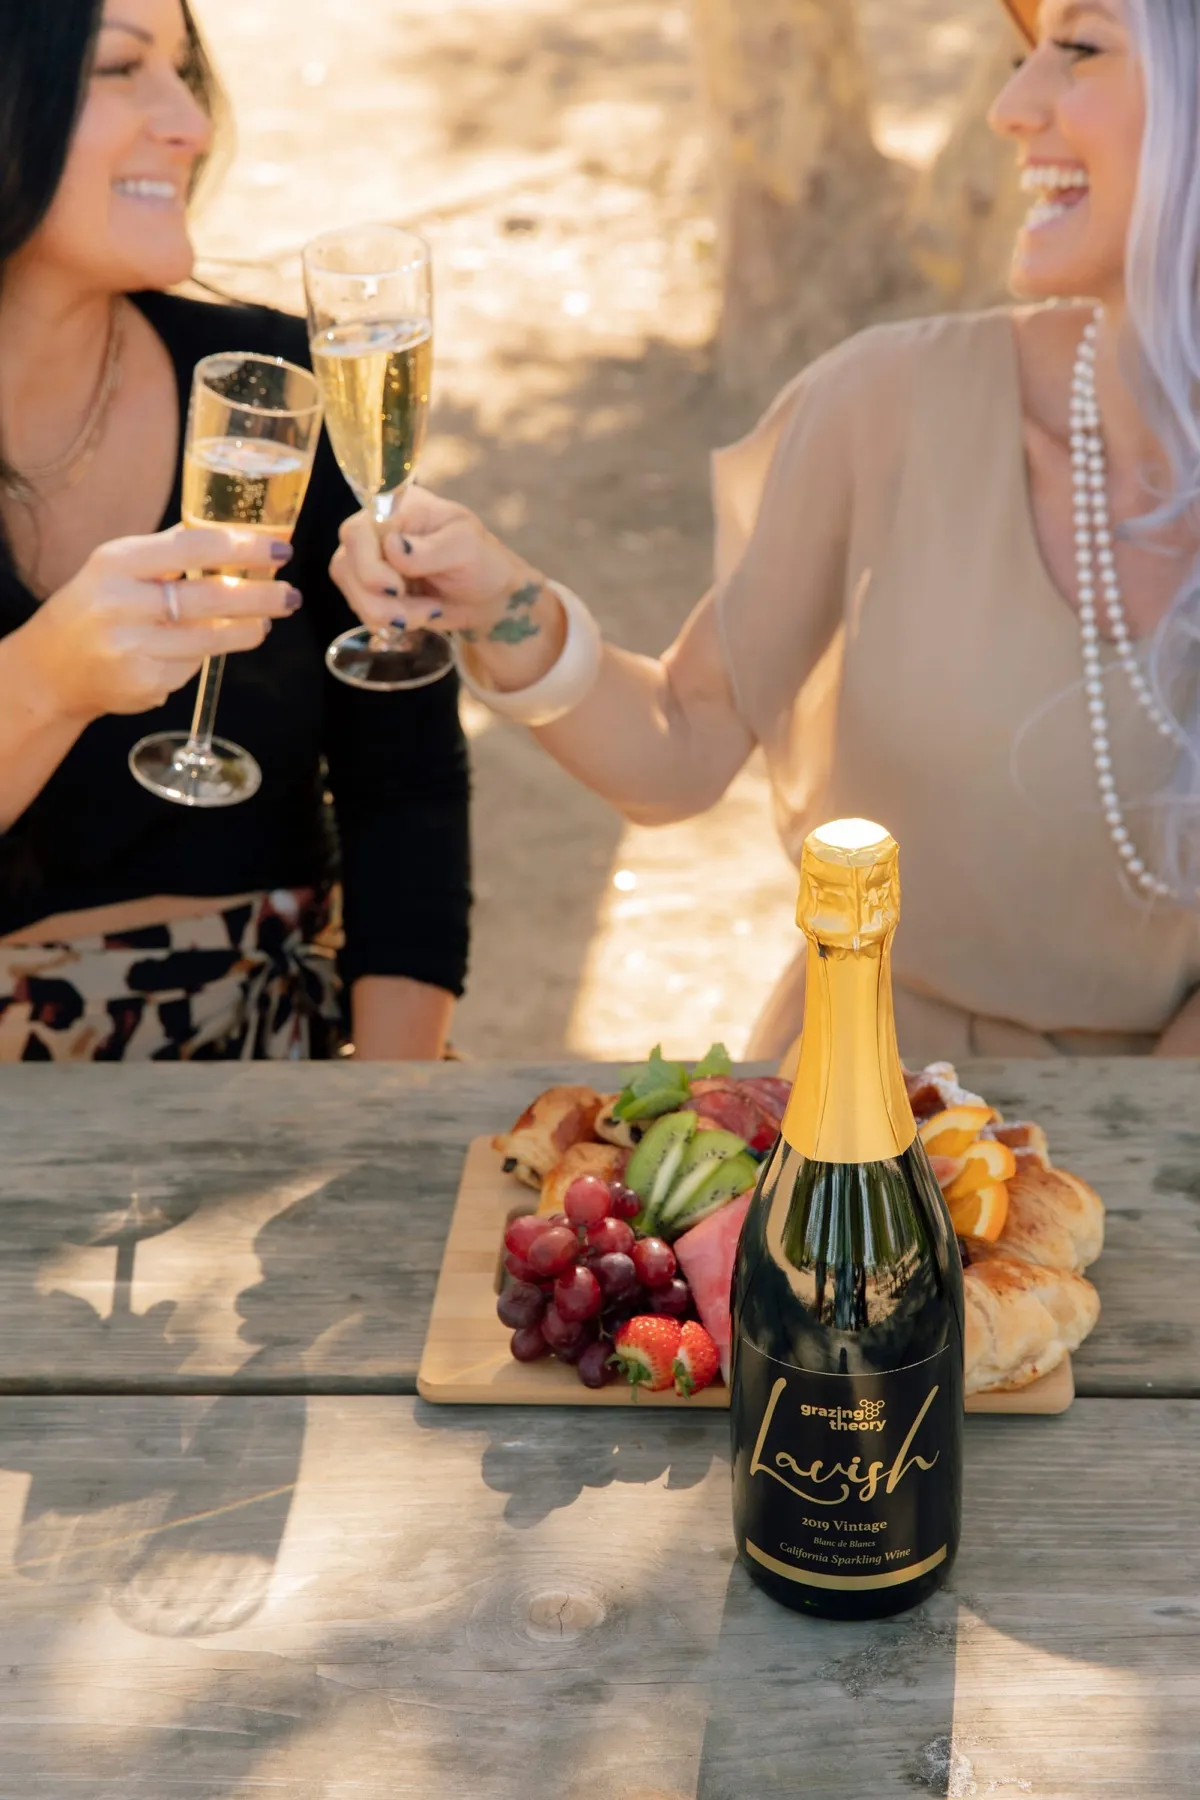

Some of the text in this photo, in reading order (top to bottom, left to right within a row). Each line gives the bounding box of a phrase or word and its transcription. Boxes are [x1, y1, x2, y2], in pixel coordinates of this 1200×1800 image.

[800, 1404, 864, 1420] grazing
[829, 1419, 887, 1432] theory
[750, 1377, 940, 1505] Lavish
[801, 1517, 887, 1533] 2019 Vintage
[813, 1536, 876, 1548] Blanc de Blancs
[779, 1541, 911, 1566] California Sparkling Wine
